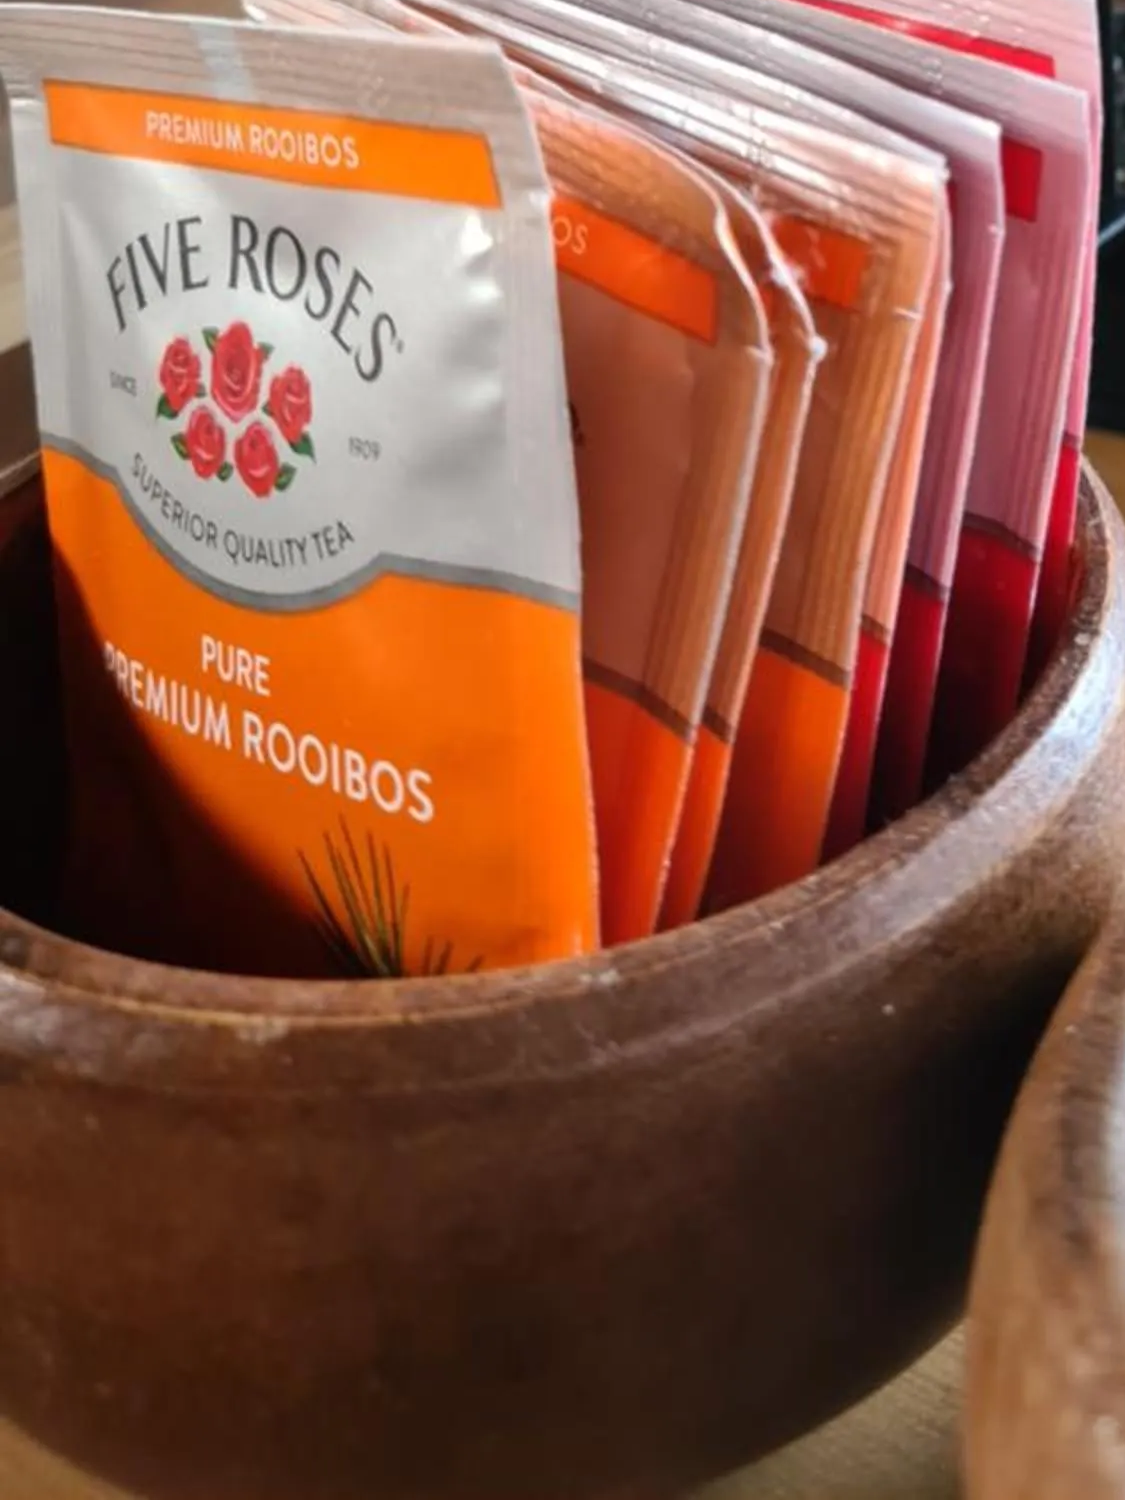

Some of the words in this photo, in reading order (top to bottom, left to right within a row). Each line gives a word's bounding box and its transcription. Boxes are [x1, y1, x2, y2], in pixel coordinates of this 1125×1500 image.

[145, 110, 244, 153] PREMIUM
[249, 123, 360, 169] ROOIBOS
[106, 215, 209, 332] FIVE
[228, 214, 398, 384] ROSES
[348, 436, 382, 462] 1909
[131, 453, 219, 551] SUPERIOR
[223, 529, 309, 569] QUALITY
[308, 520, 355, 562] TEA
[201, 634, 271, 697] PURE
[243, 710, 434, 823] ROOIBOS
